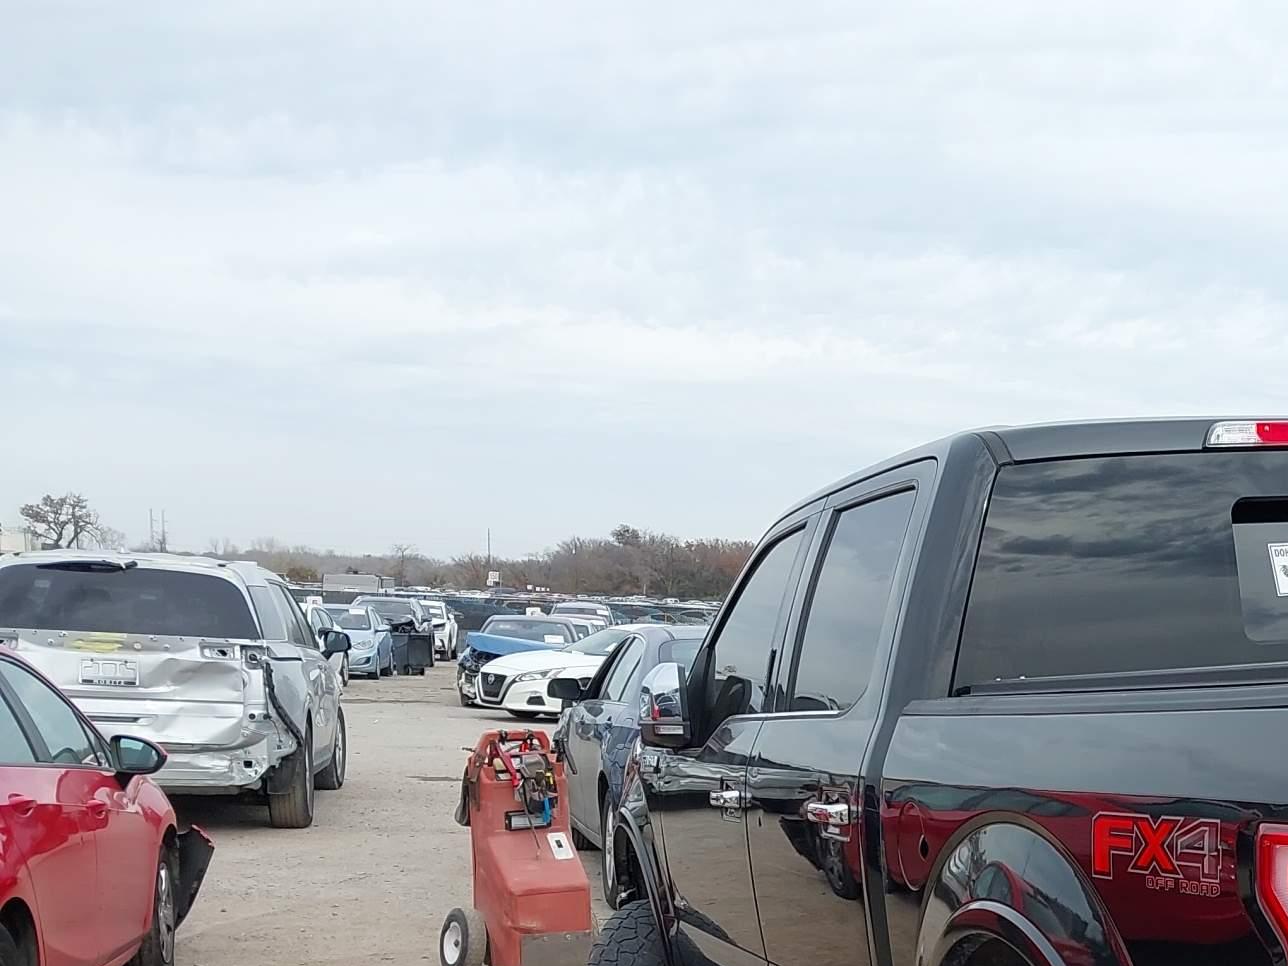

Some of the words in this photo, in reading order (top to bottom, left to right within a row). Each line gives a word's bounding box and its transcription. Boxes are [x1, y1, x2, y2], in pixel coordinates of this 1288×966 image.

[1091, 811, 1221, 882] FX4
[1146, 876, 1174, 890] OFF
[1180, 880, 1220, 897] ROAD
